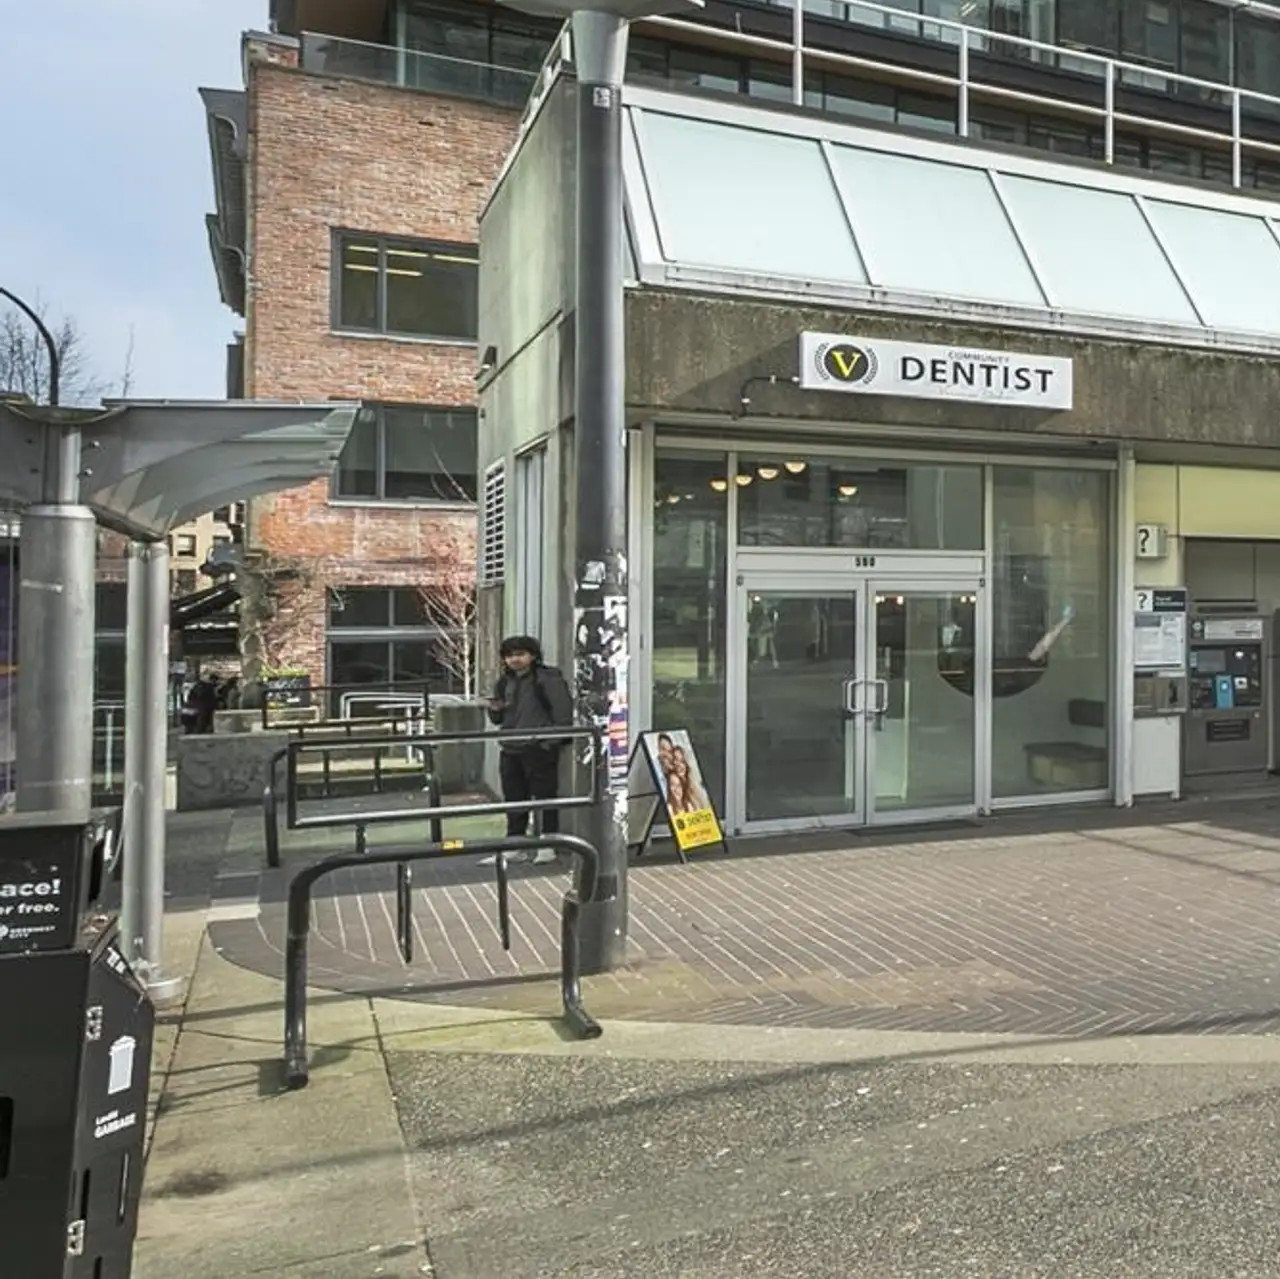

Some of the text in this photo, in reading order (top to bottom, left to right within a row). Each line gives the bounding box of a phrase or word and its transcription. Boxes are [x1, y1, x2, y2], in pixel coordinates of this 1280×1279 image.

[832, 351, 861, 378] V
[948, 350, 1011, 364] COMMUNITY
[900, 355, 1054, 393] DENTIST
